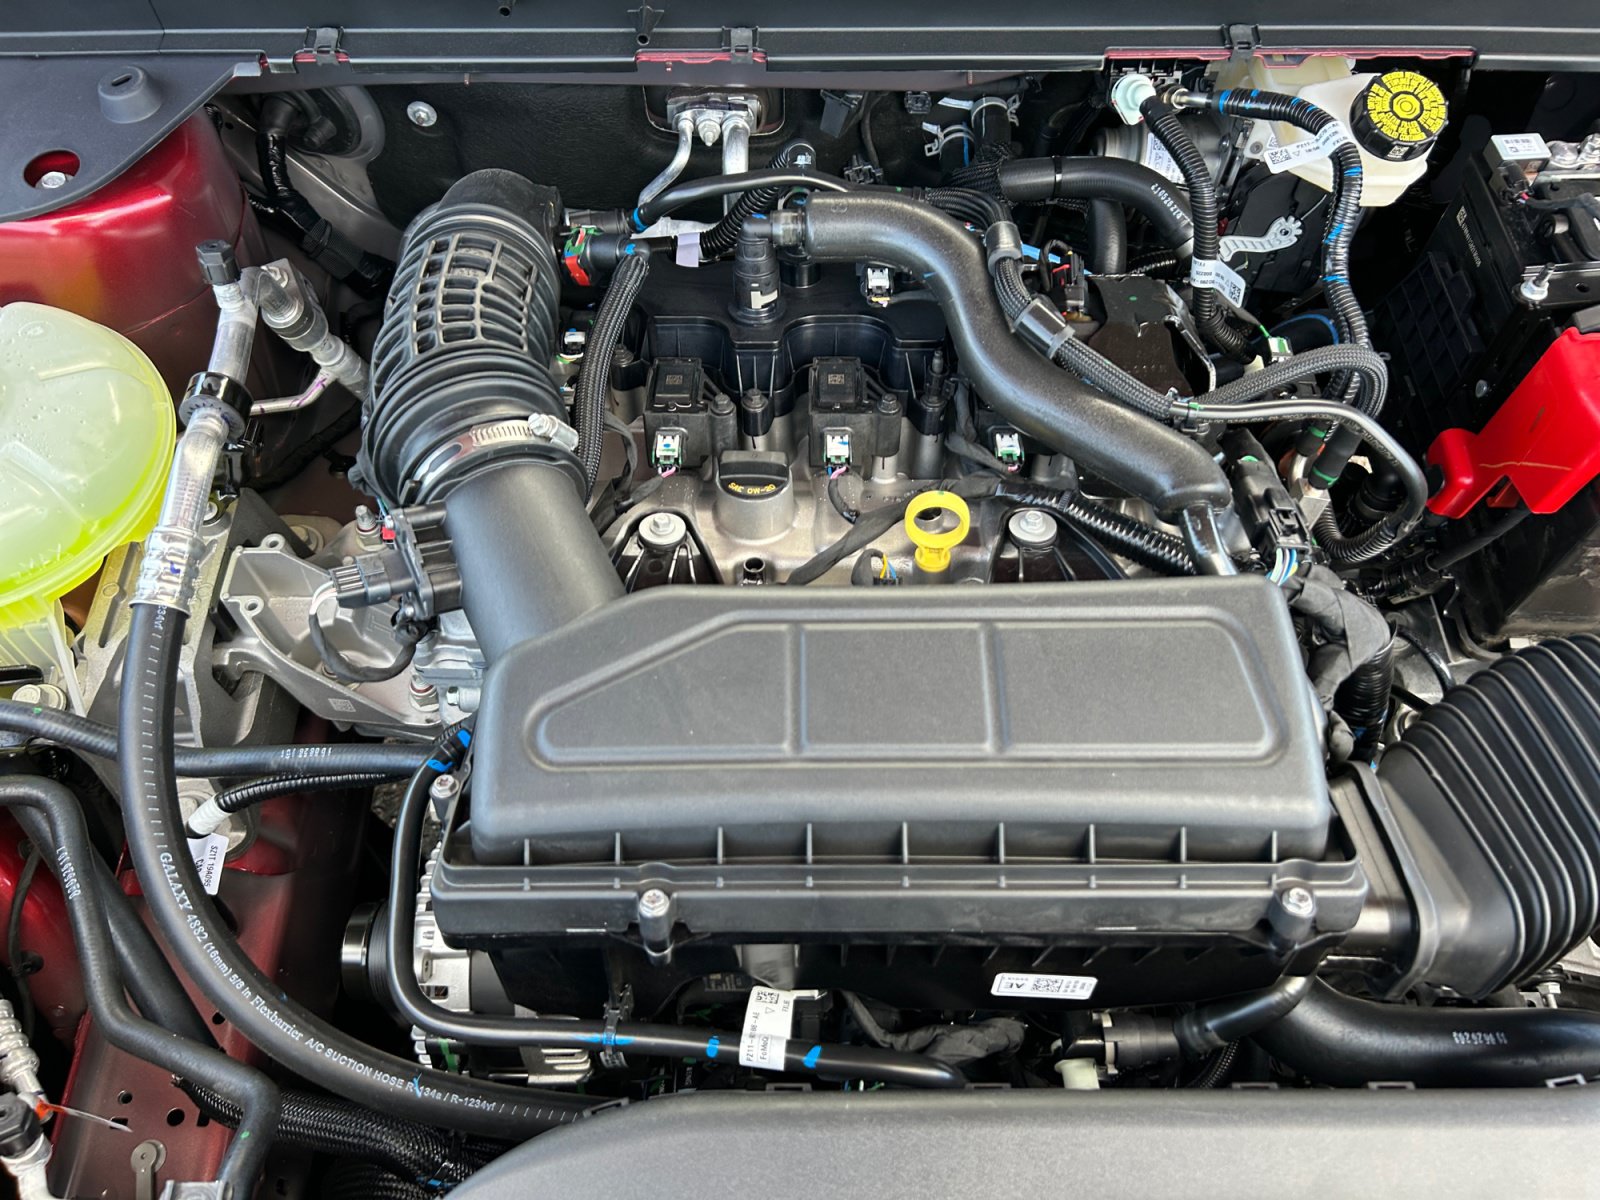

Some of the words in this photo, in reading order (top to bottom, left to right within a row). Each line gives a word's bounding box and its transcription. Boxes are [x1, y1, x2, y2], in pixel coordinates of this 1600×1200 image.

[728, 482, 745, 493] SAE
[160, 852, 193, 910] GALAXY
[186, 914, 208, 942] 4882
[203, 942, 232, 977] (16mm)
[229, 974, 245, 990] 5/8
[250, 994, 304, 1041] Flexbarrier
[305, 1037, 325, 1053] A/C
[325, 1048, 373, 1077] SUCTION
[374, 1070, 405, 1088] HOSE
